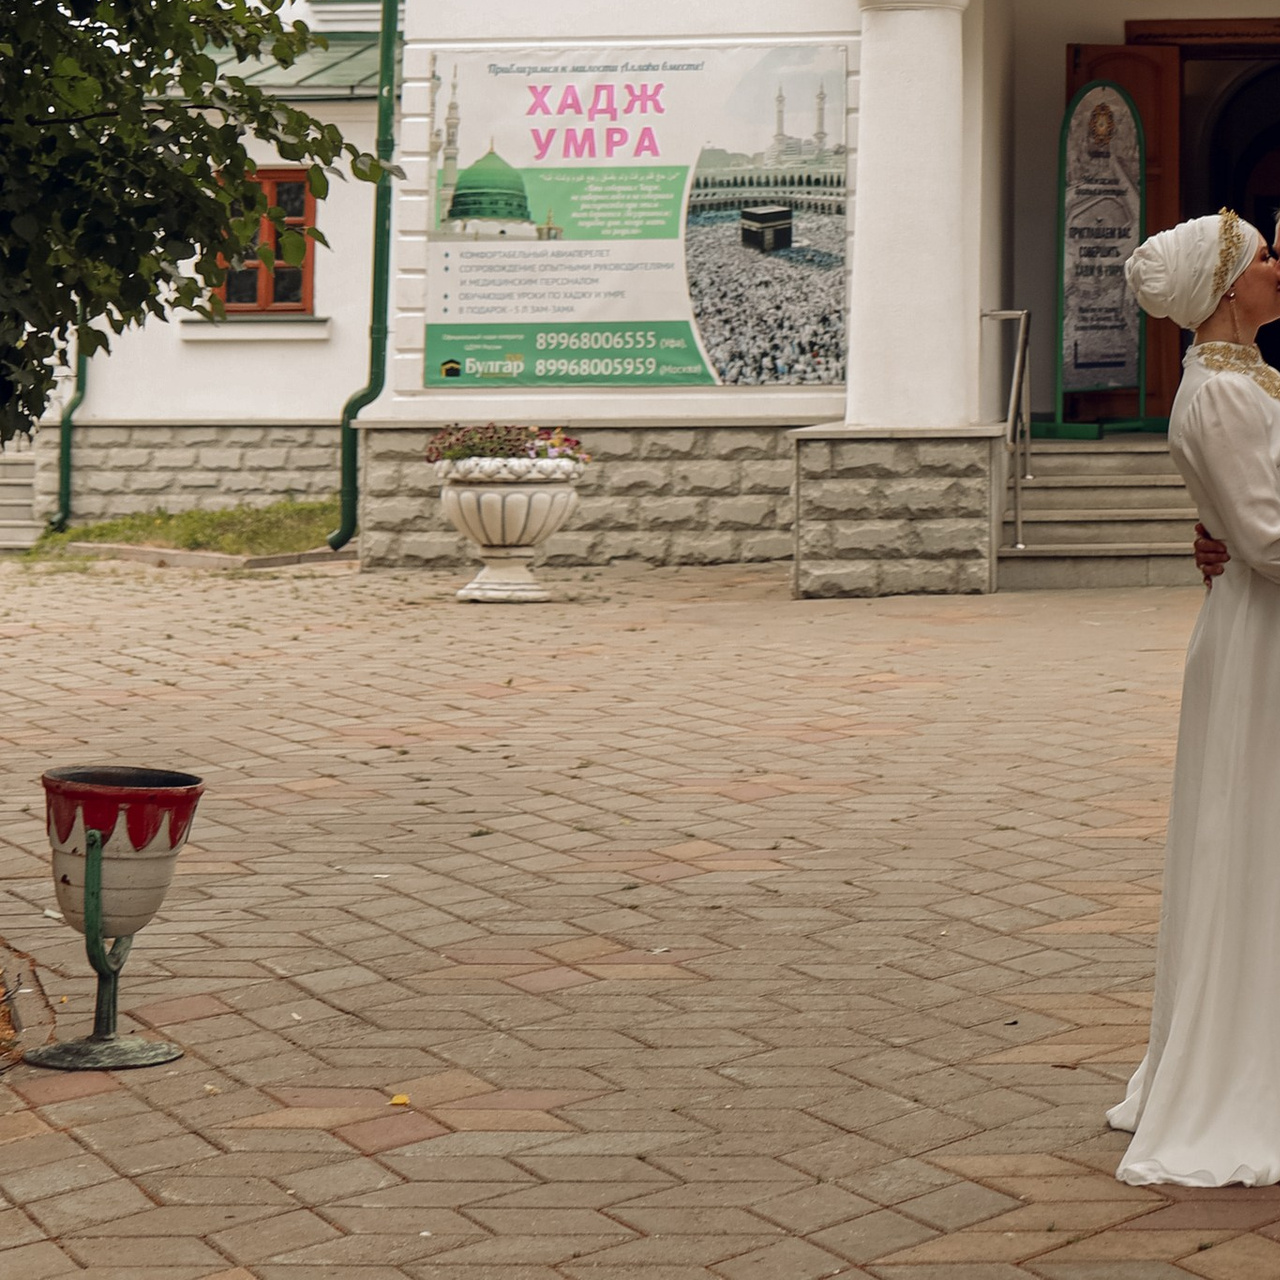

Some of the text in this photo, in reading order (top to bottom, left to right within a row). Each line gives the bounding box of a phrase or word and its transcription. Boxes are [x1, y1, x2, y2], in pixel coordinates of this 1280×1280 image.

[526, 83, 665, 122] ХАДЖ
[530, 126, 660, 160] УМРА
[459, 249, 548, 259] КОМФОРТАБЕЛЬНЫЙ
[459, 262, 675, 273] СОПРОВОЖДЕНИЕ ОПЫТНЫМИ РУКОВОДИТЕЛЯМИ
[469, 278, 537, 287] МЕДИЦИНСКИМ
[540, 277, 599, 286] ПЕРСОНАЛОМ
[459, 292, 514, 301] ОБУЧАЮЩИЕ
[548, 292, 560, 300] ПО
[563, 291, 592, 299] ХАДЖУ
[603, 290, 625, 299] УМРЕ
[466, 305, 507, 315] ПОДАРОК
[535, 331, 656, 350] 89968006555
[465, 357, 525, 378] Булгар
[535, 357, 656, 376] 89968005959
